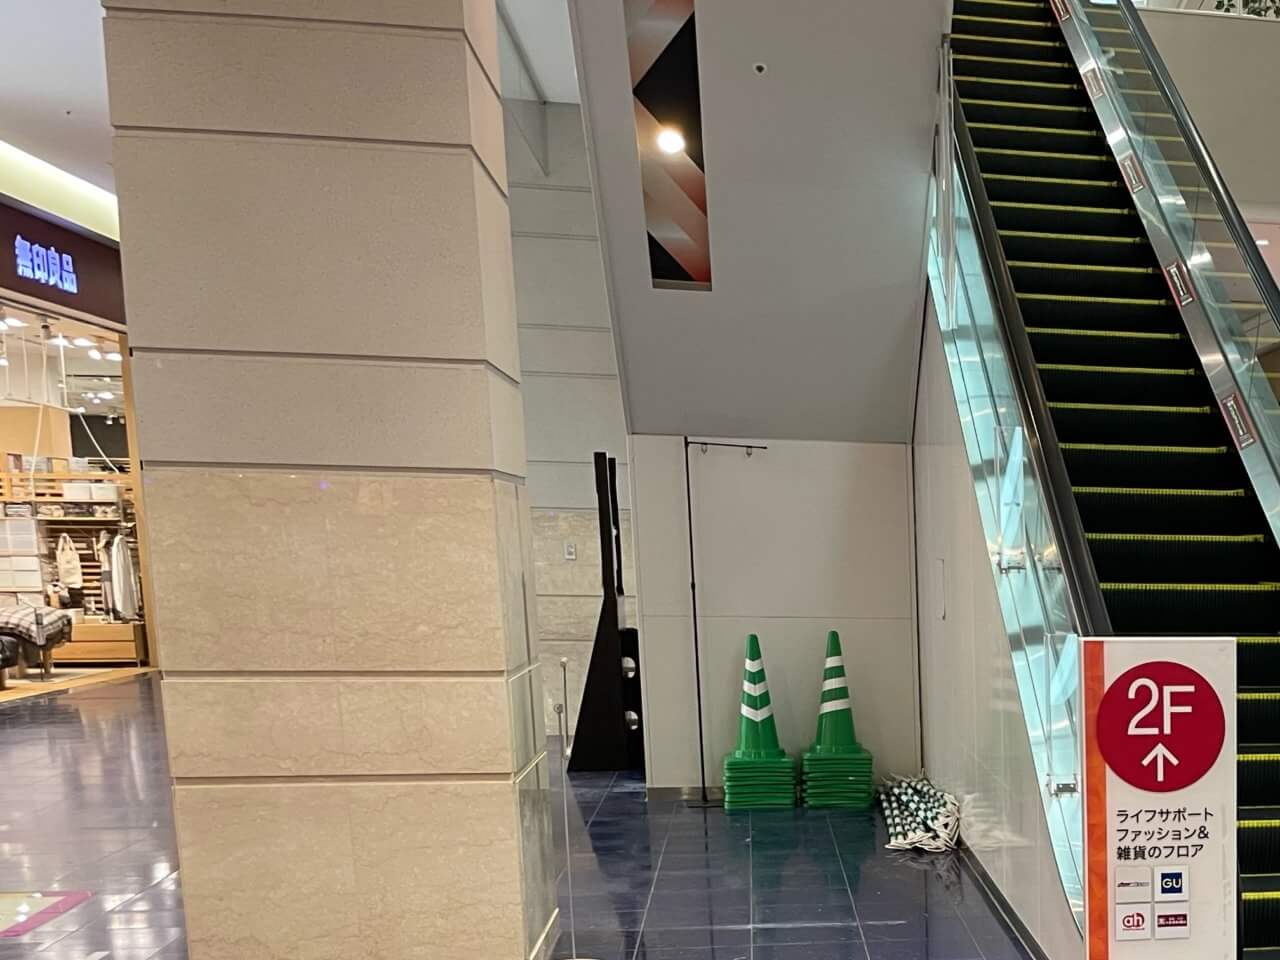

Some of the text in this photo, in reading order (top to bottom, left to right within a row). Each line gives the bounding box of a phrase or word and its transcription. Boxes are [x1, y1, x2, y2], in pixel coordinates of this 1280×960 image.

[15, 234, 78, 293] 無印良品
[1126, 677, 1196, 736] 2F
[1116, 807, 1214, 825] ライフサポート
[1116, 826, 1209, 842] ファッション&
[1116, 844, 1204, 861] 雑貨のフロア
[1162, 878, 1182, 889] GU
